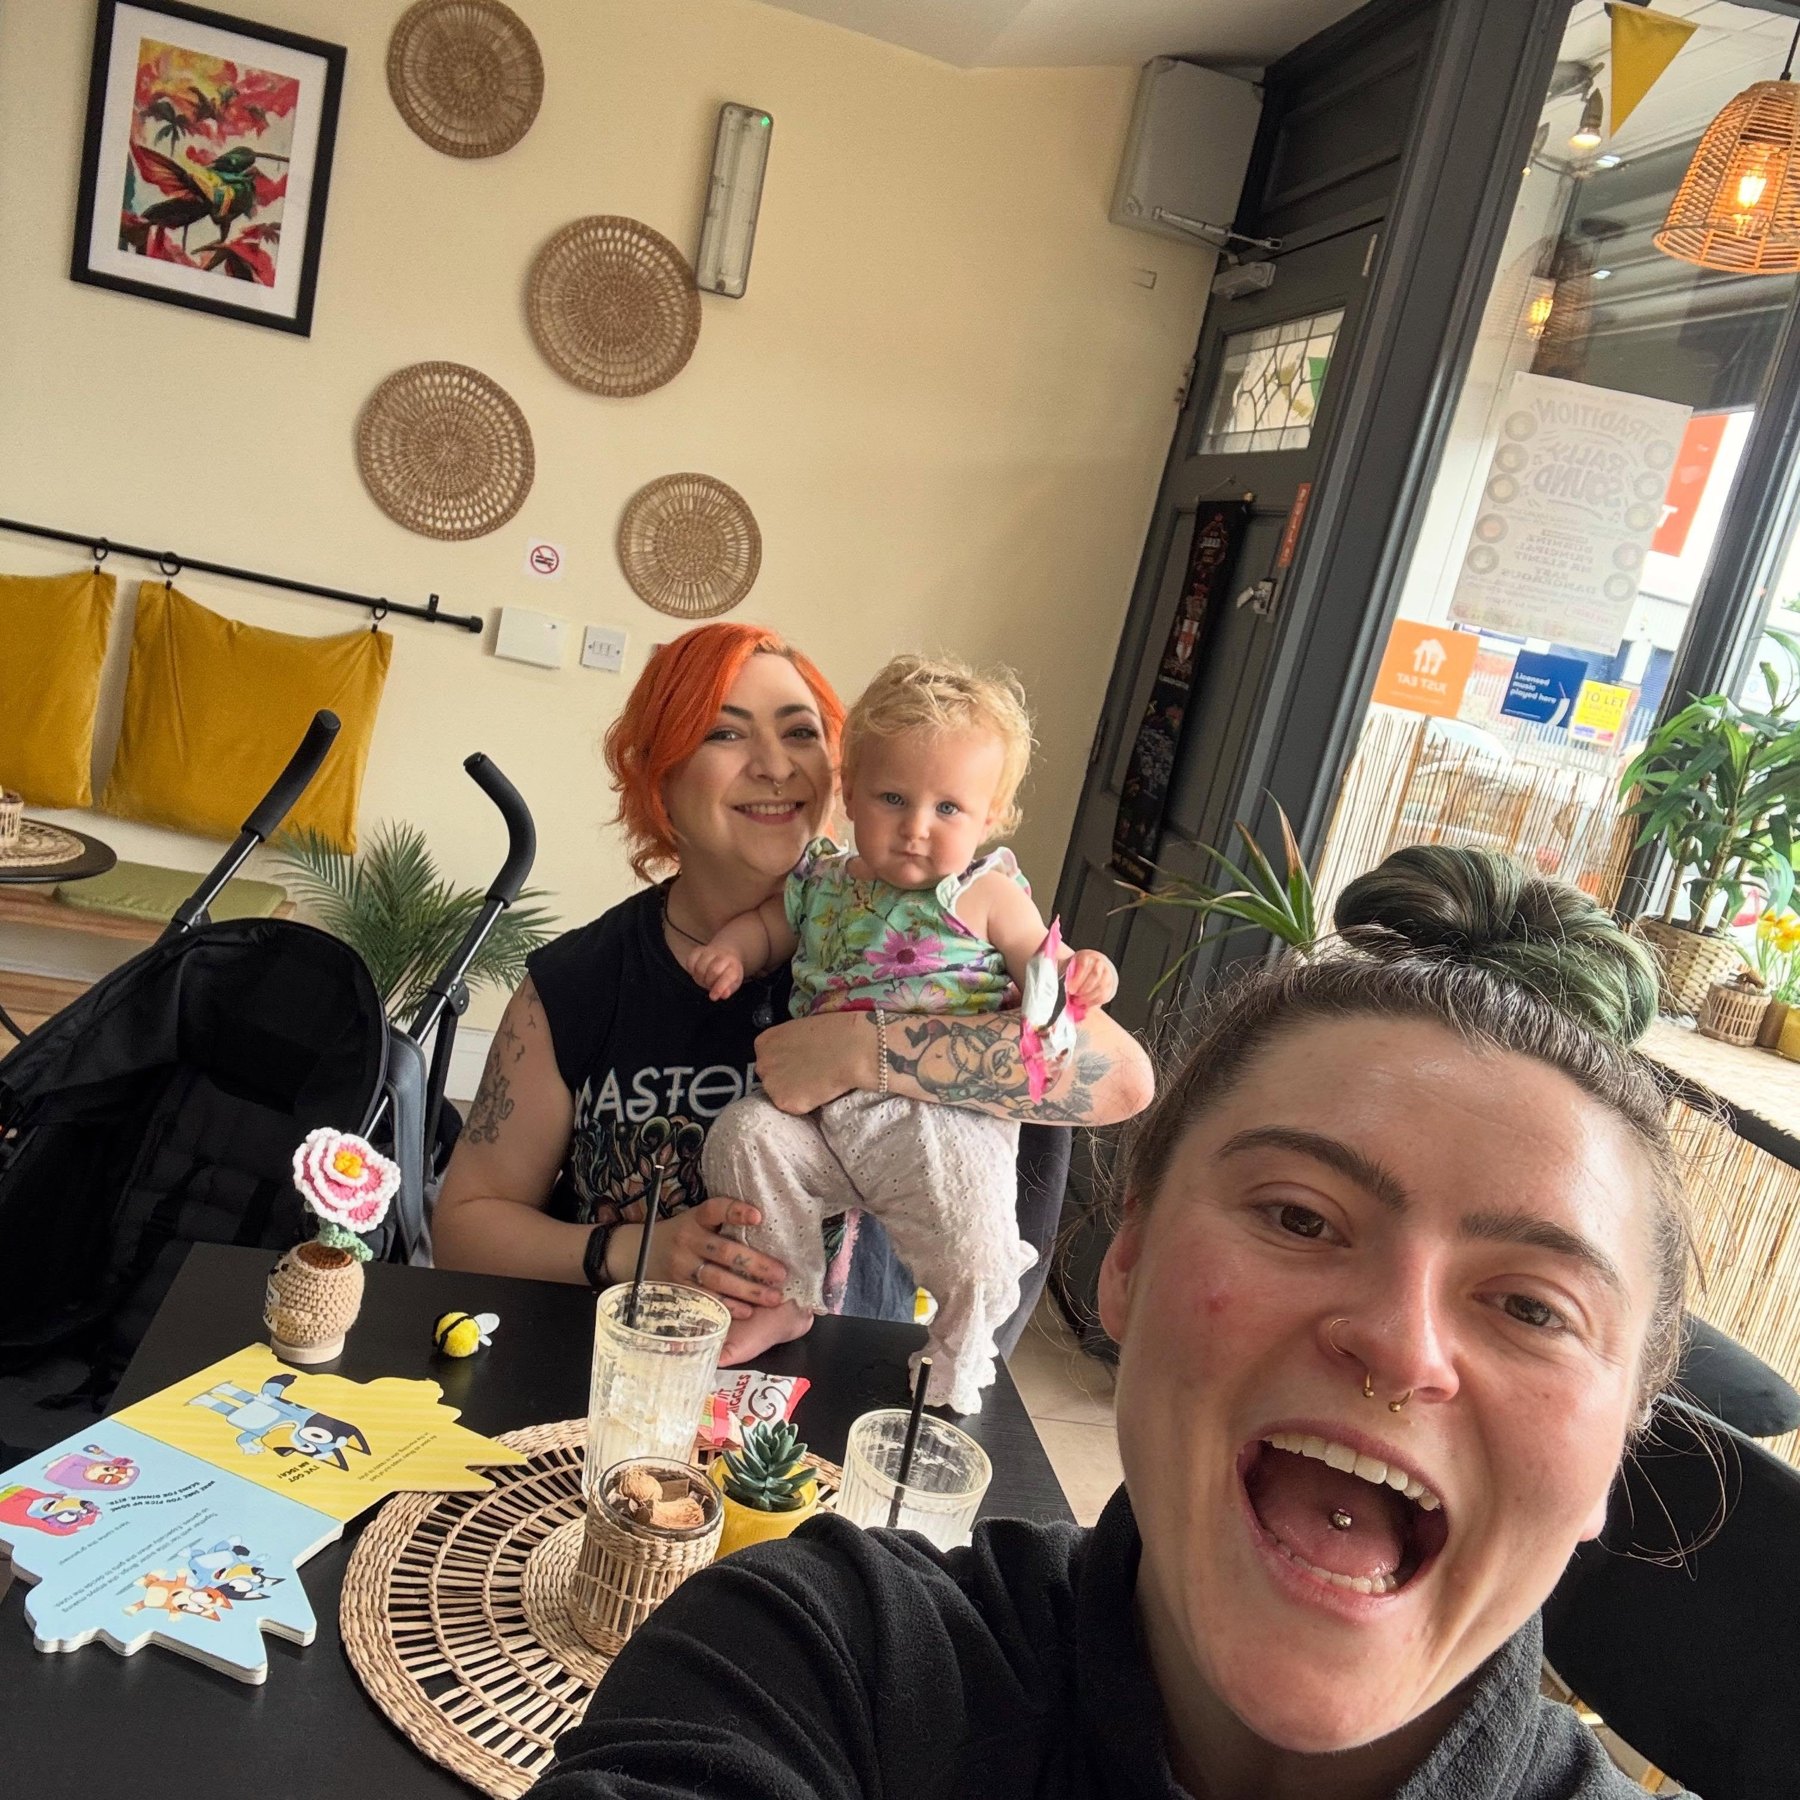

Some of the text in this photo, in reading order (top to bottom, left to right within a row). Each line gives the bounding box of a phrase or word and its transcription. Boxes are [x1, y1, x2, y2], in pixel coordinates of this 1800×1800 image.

[1512, 680, 1537, 692] music
[1515, 671, 1551, 687] Licensed
[1510, 687, 1557, 705] played here
[1604, 694, 1625, 709] LET
[288, 1473, 305, 1482] GOT
